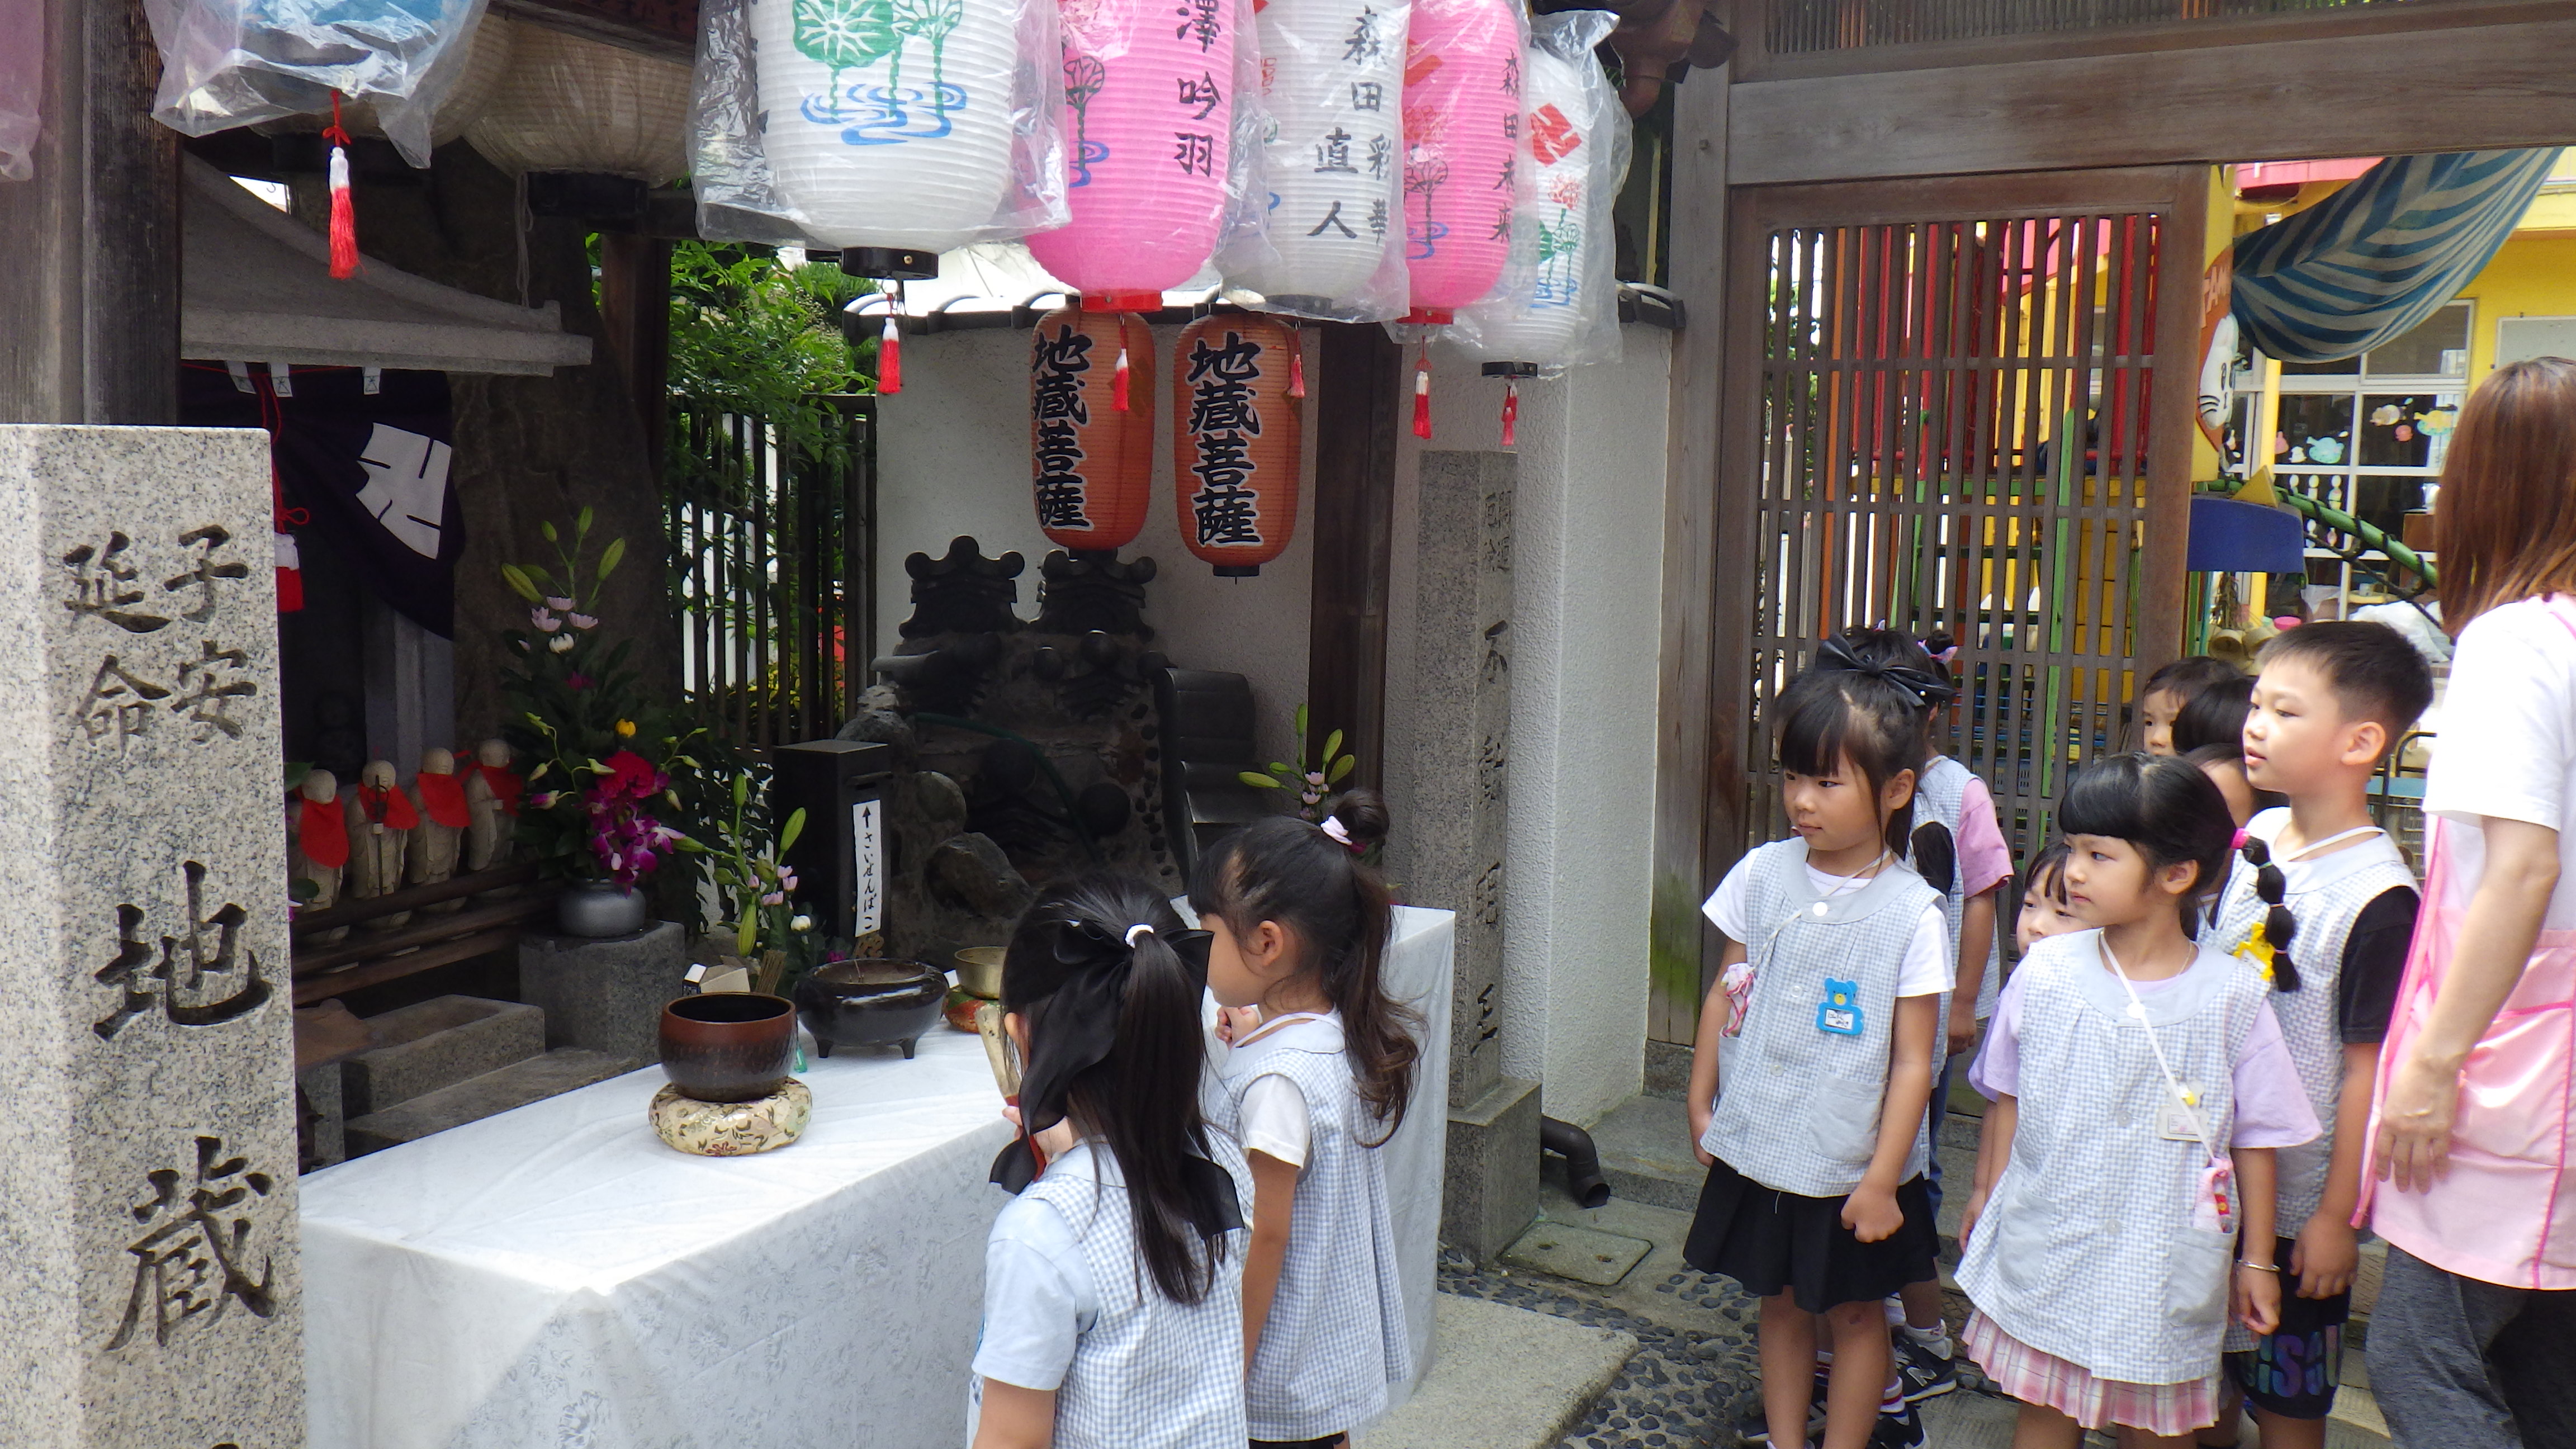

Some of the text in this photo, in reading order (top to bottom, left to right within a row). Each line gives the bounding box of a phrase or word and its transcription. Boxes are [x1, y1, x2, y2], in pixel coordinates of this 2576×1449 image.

[1033, 324, 1093, 529] 地蔵菩薩
[1187, 331, 1262, 546] 地蔵菩薩
[63, 530, 172, 760] 延命
[164, 524, 258, 747] 子安
[863, 832, 878, 930] さいせんばこ
[94, 860, 276, 1449] 地蔵
